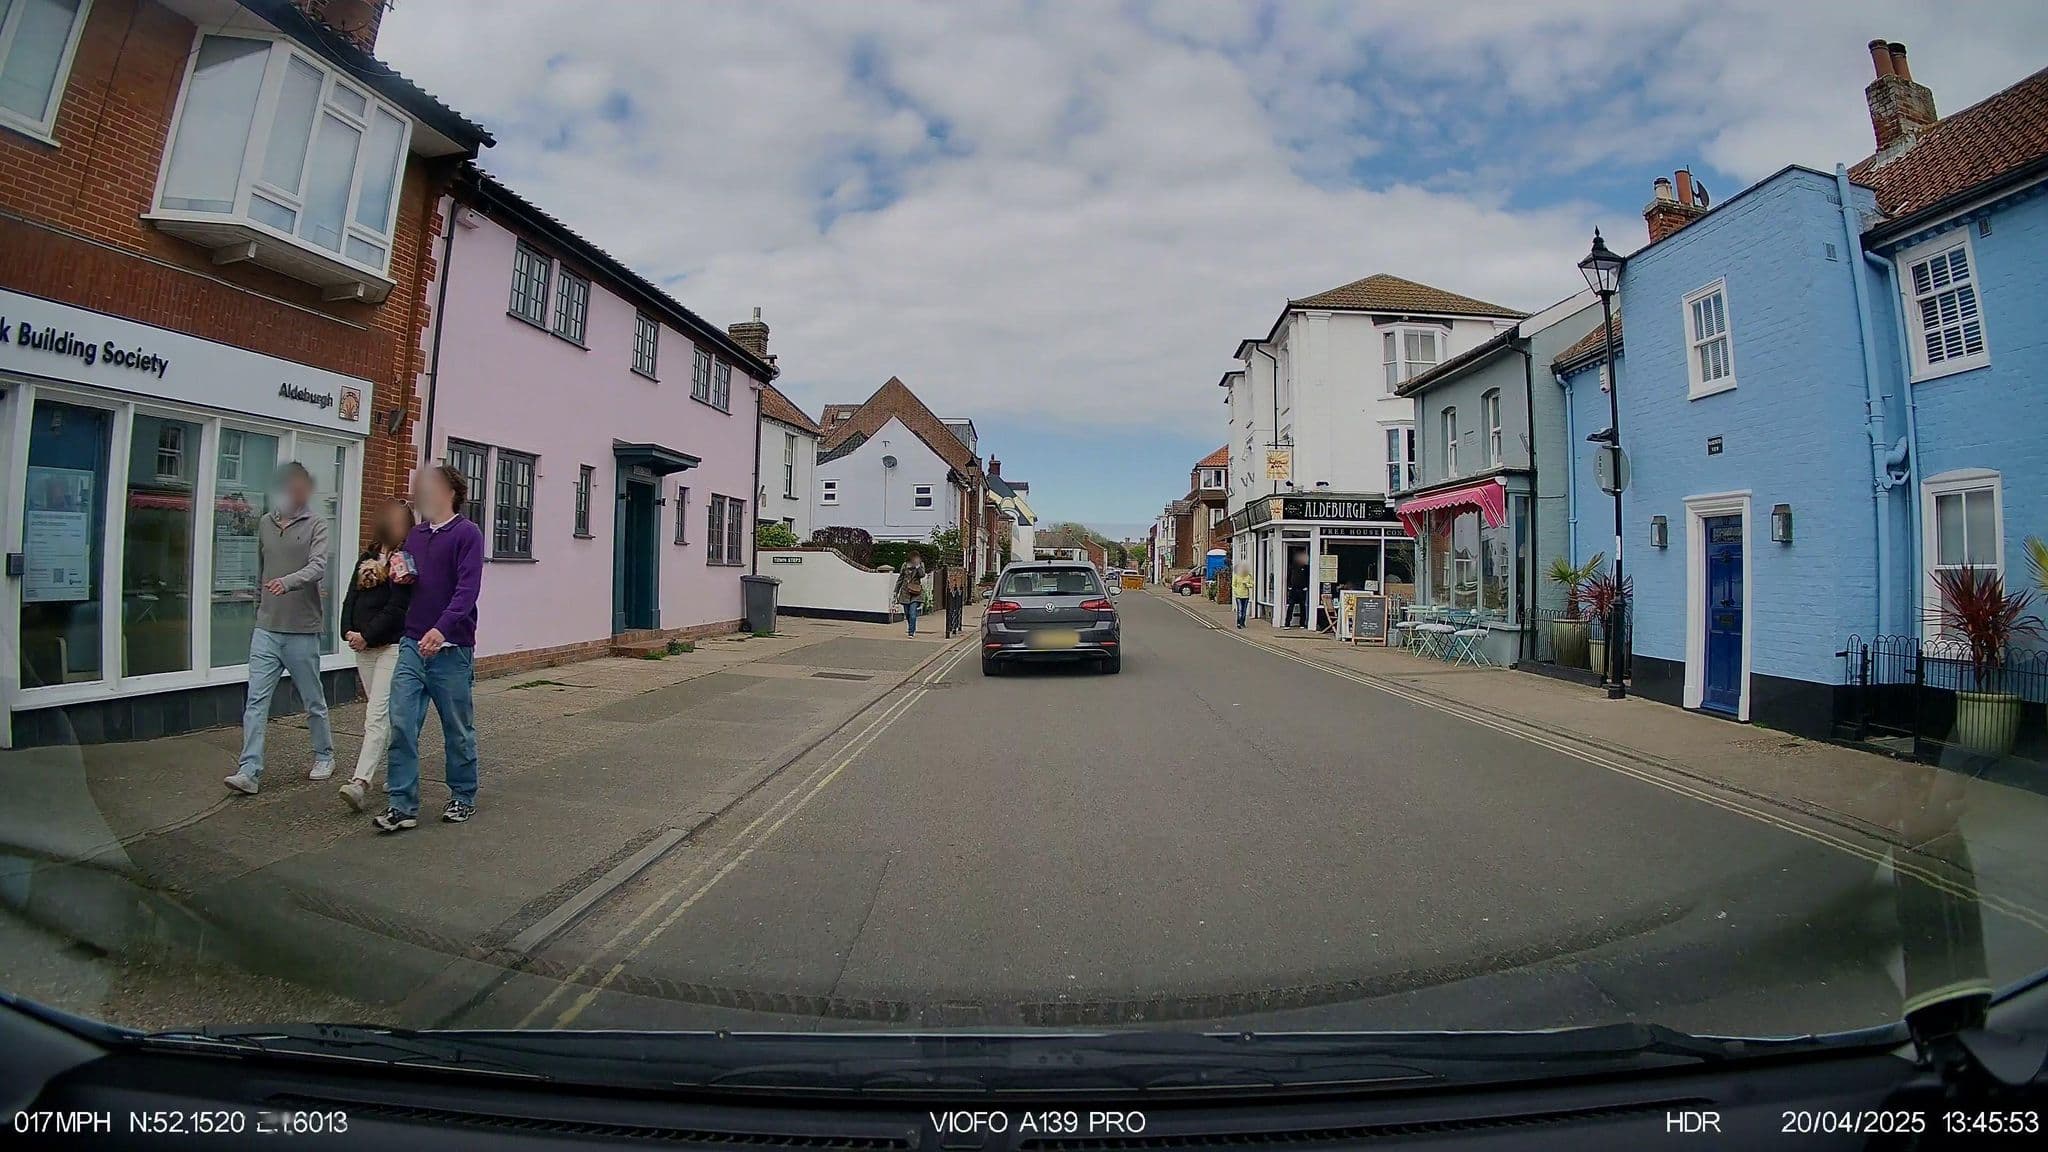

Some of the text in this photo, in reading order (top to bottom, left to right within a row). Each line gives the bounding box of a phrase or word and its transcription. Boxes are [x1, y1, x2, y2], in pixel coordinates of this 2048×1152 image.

[18, 321, 97, 366] Building
[102, 340, 169, 378] Society
[279, 382, 333, 409] Aldeburgh
[1304, 501, 1366, 519] ALDEBURGH
[1349, 528, 1379, 536] HOUSE
